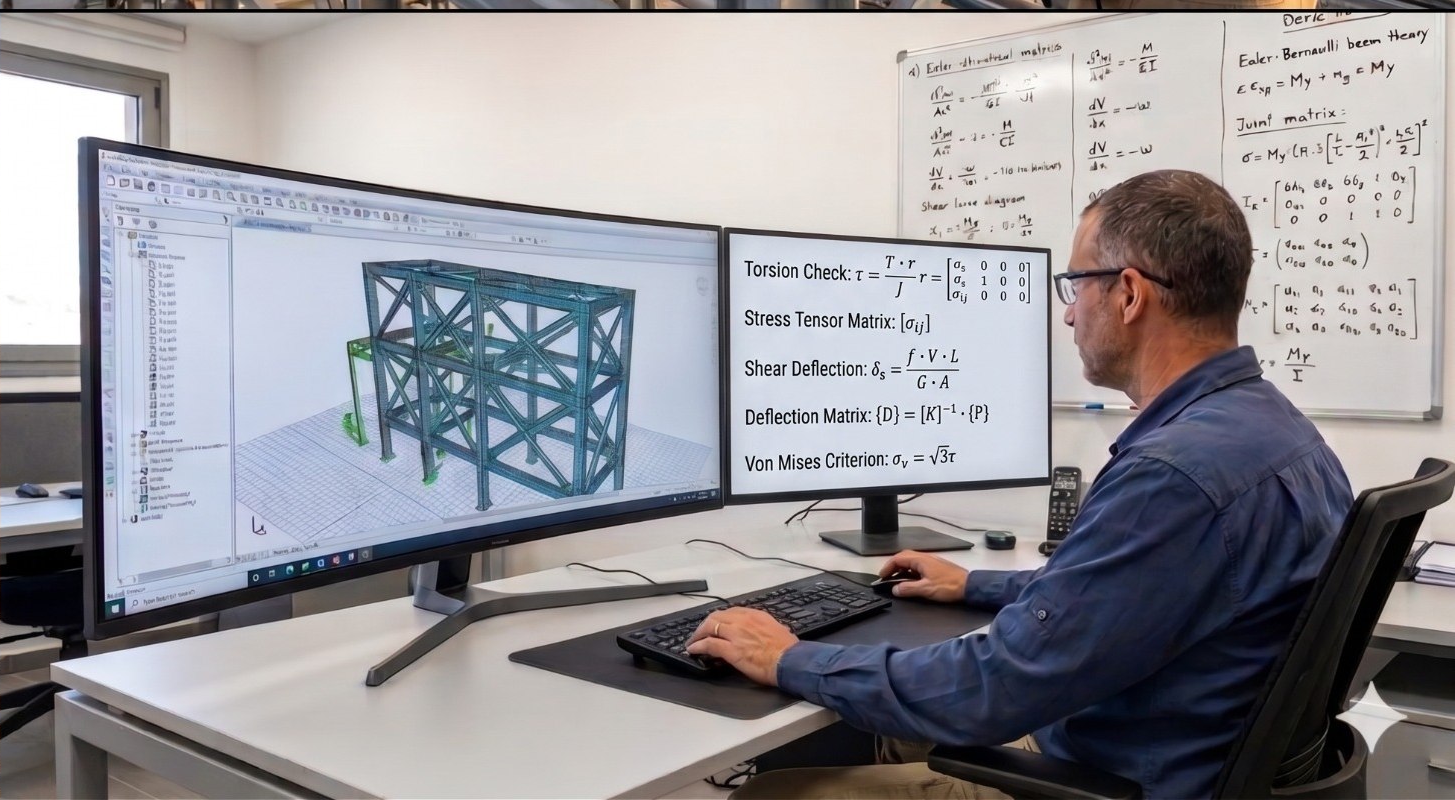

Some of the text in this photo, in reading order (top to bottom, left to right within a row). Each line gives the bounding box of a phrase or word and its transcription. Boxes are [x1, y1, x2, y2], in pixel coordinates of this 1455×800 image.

[743, 260, 799, 279] Torsion
[803, 262, 852, 282] Check:
[980, 260, 988, 271] 0
[999, 261, 1007, 272] 0
[981, 275, 987, 286] 1
[999, 275, 1007, 287] 0
[980, 290, 988, 301] 0
[1000, 290, 1007, 301] 0
[744, 309, 791, 328] Stress
[795, 311, 844, 329] Tensor
[848, 312, 896, 330] Matrix:
[744, 360, 788, 377] Shear
[792, 360, 868, 377] Deflection:
[745, 407, 819, 426] Deflection
[823, 407, 872, 424] Matrix:
[875, 404, 900, 426] {D}
[968, 403, 990, 424] {P}
[744, 455, 774, 472] Von
[778, 454, 821, 471] Mises
[825, 451, 889, 469] Criterion:
